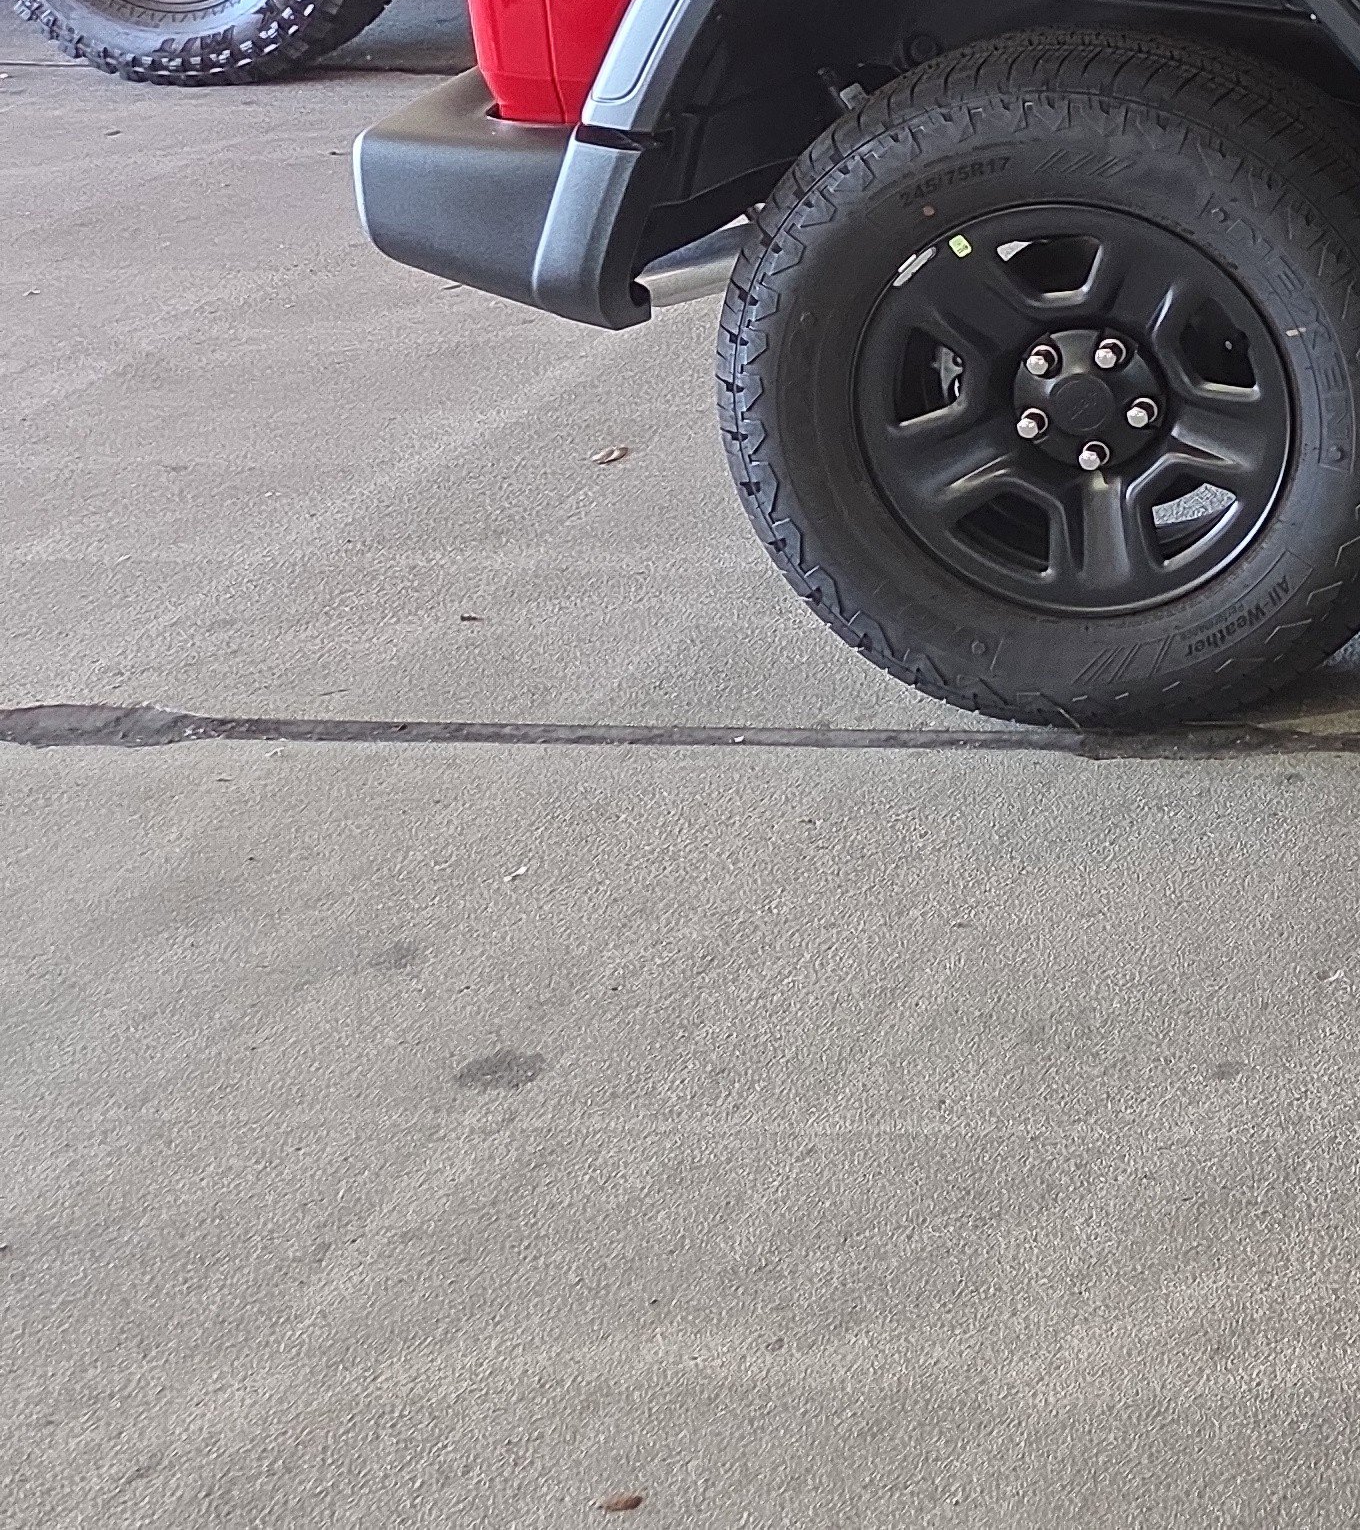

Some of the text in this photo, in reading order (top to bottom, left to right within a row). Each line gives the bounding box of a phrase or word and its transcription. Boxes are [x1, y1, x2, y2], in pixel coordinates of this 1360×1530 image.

[899, 155, 1012, 208] 245/75R17
[1227, 218, 1351, 442] NEXEN
[1184, 575, 1291, 658] All-Weather
